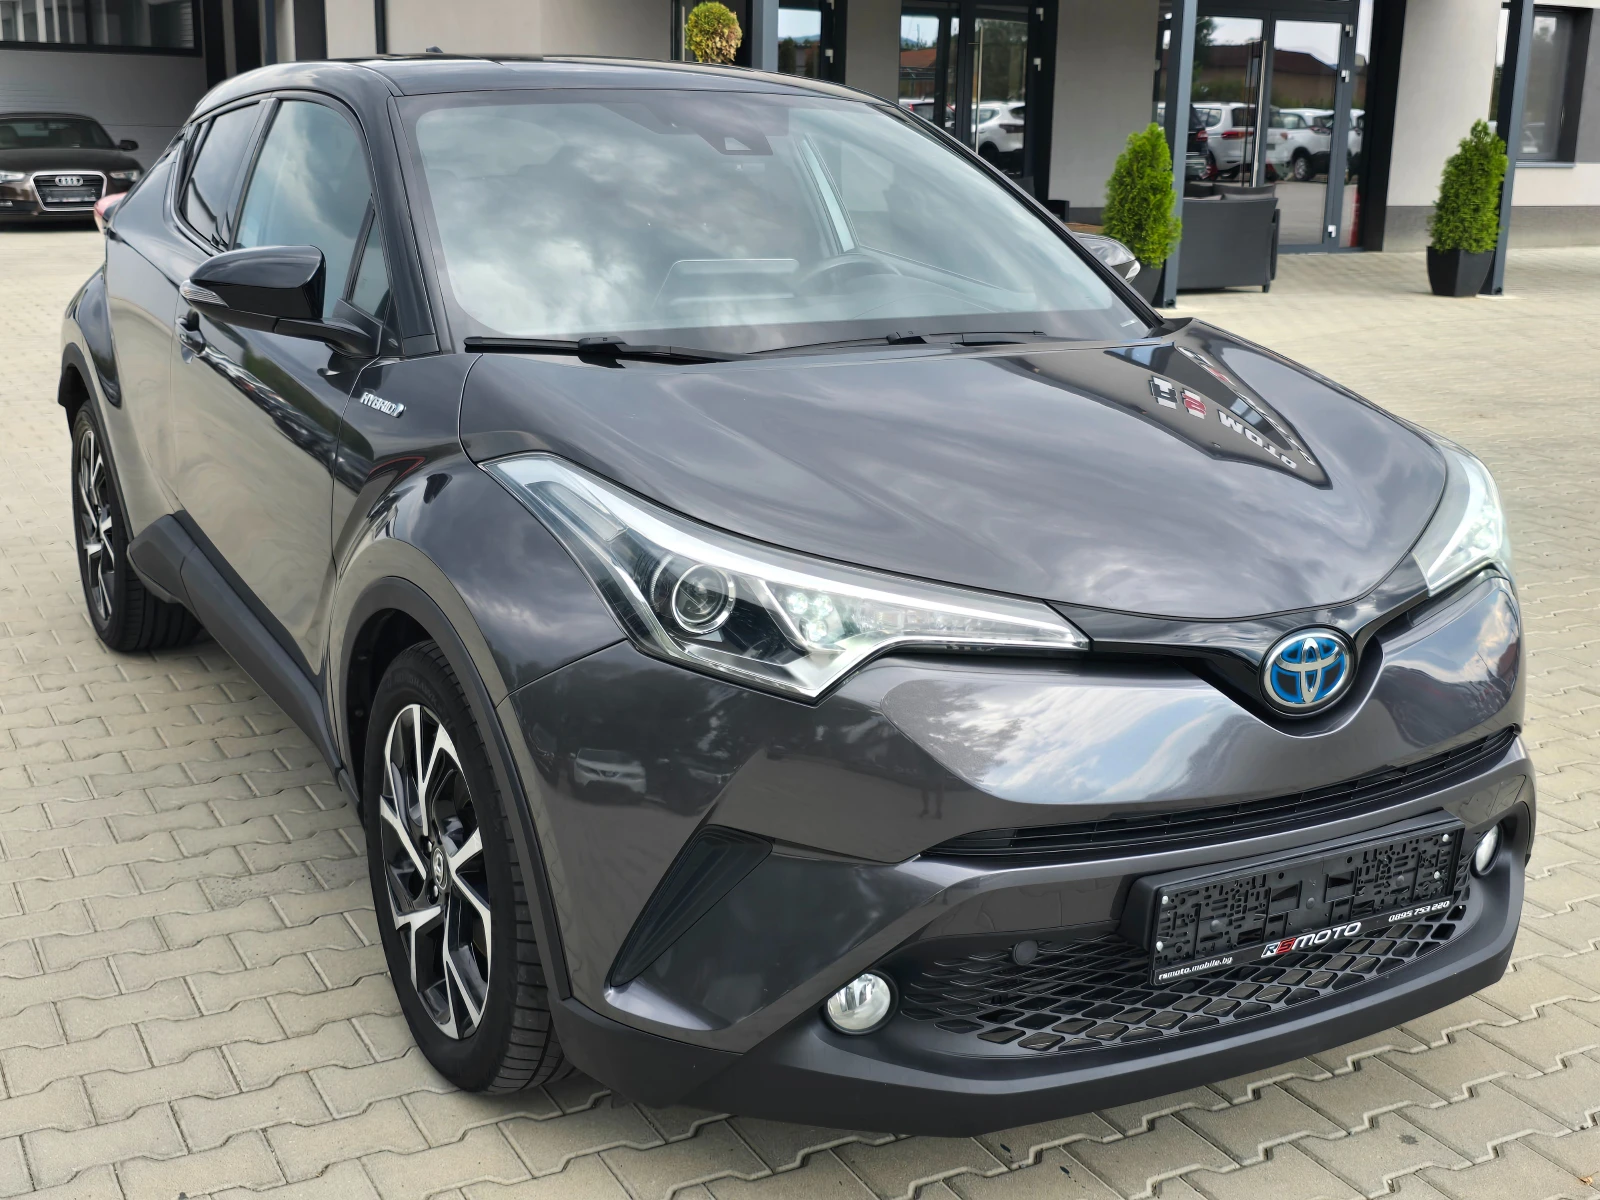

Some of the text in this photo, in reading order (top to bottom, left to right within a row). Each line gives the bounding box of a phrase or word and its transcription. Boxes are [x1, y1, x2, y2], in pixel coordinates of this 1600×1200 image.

[360, 391, 397, 416] HYBRID
[1388, 910, 1413, 922] 0895
[1414, 905, 1431, 916] 753
[1158, 956, 1234, 980] rsmoto.mobile.bg
